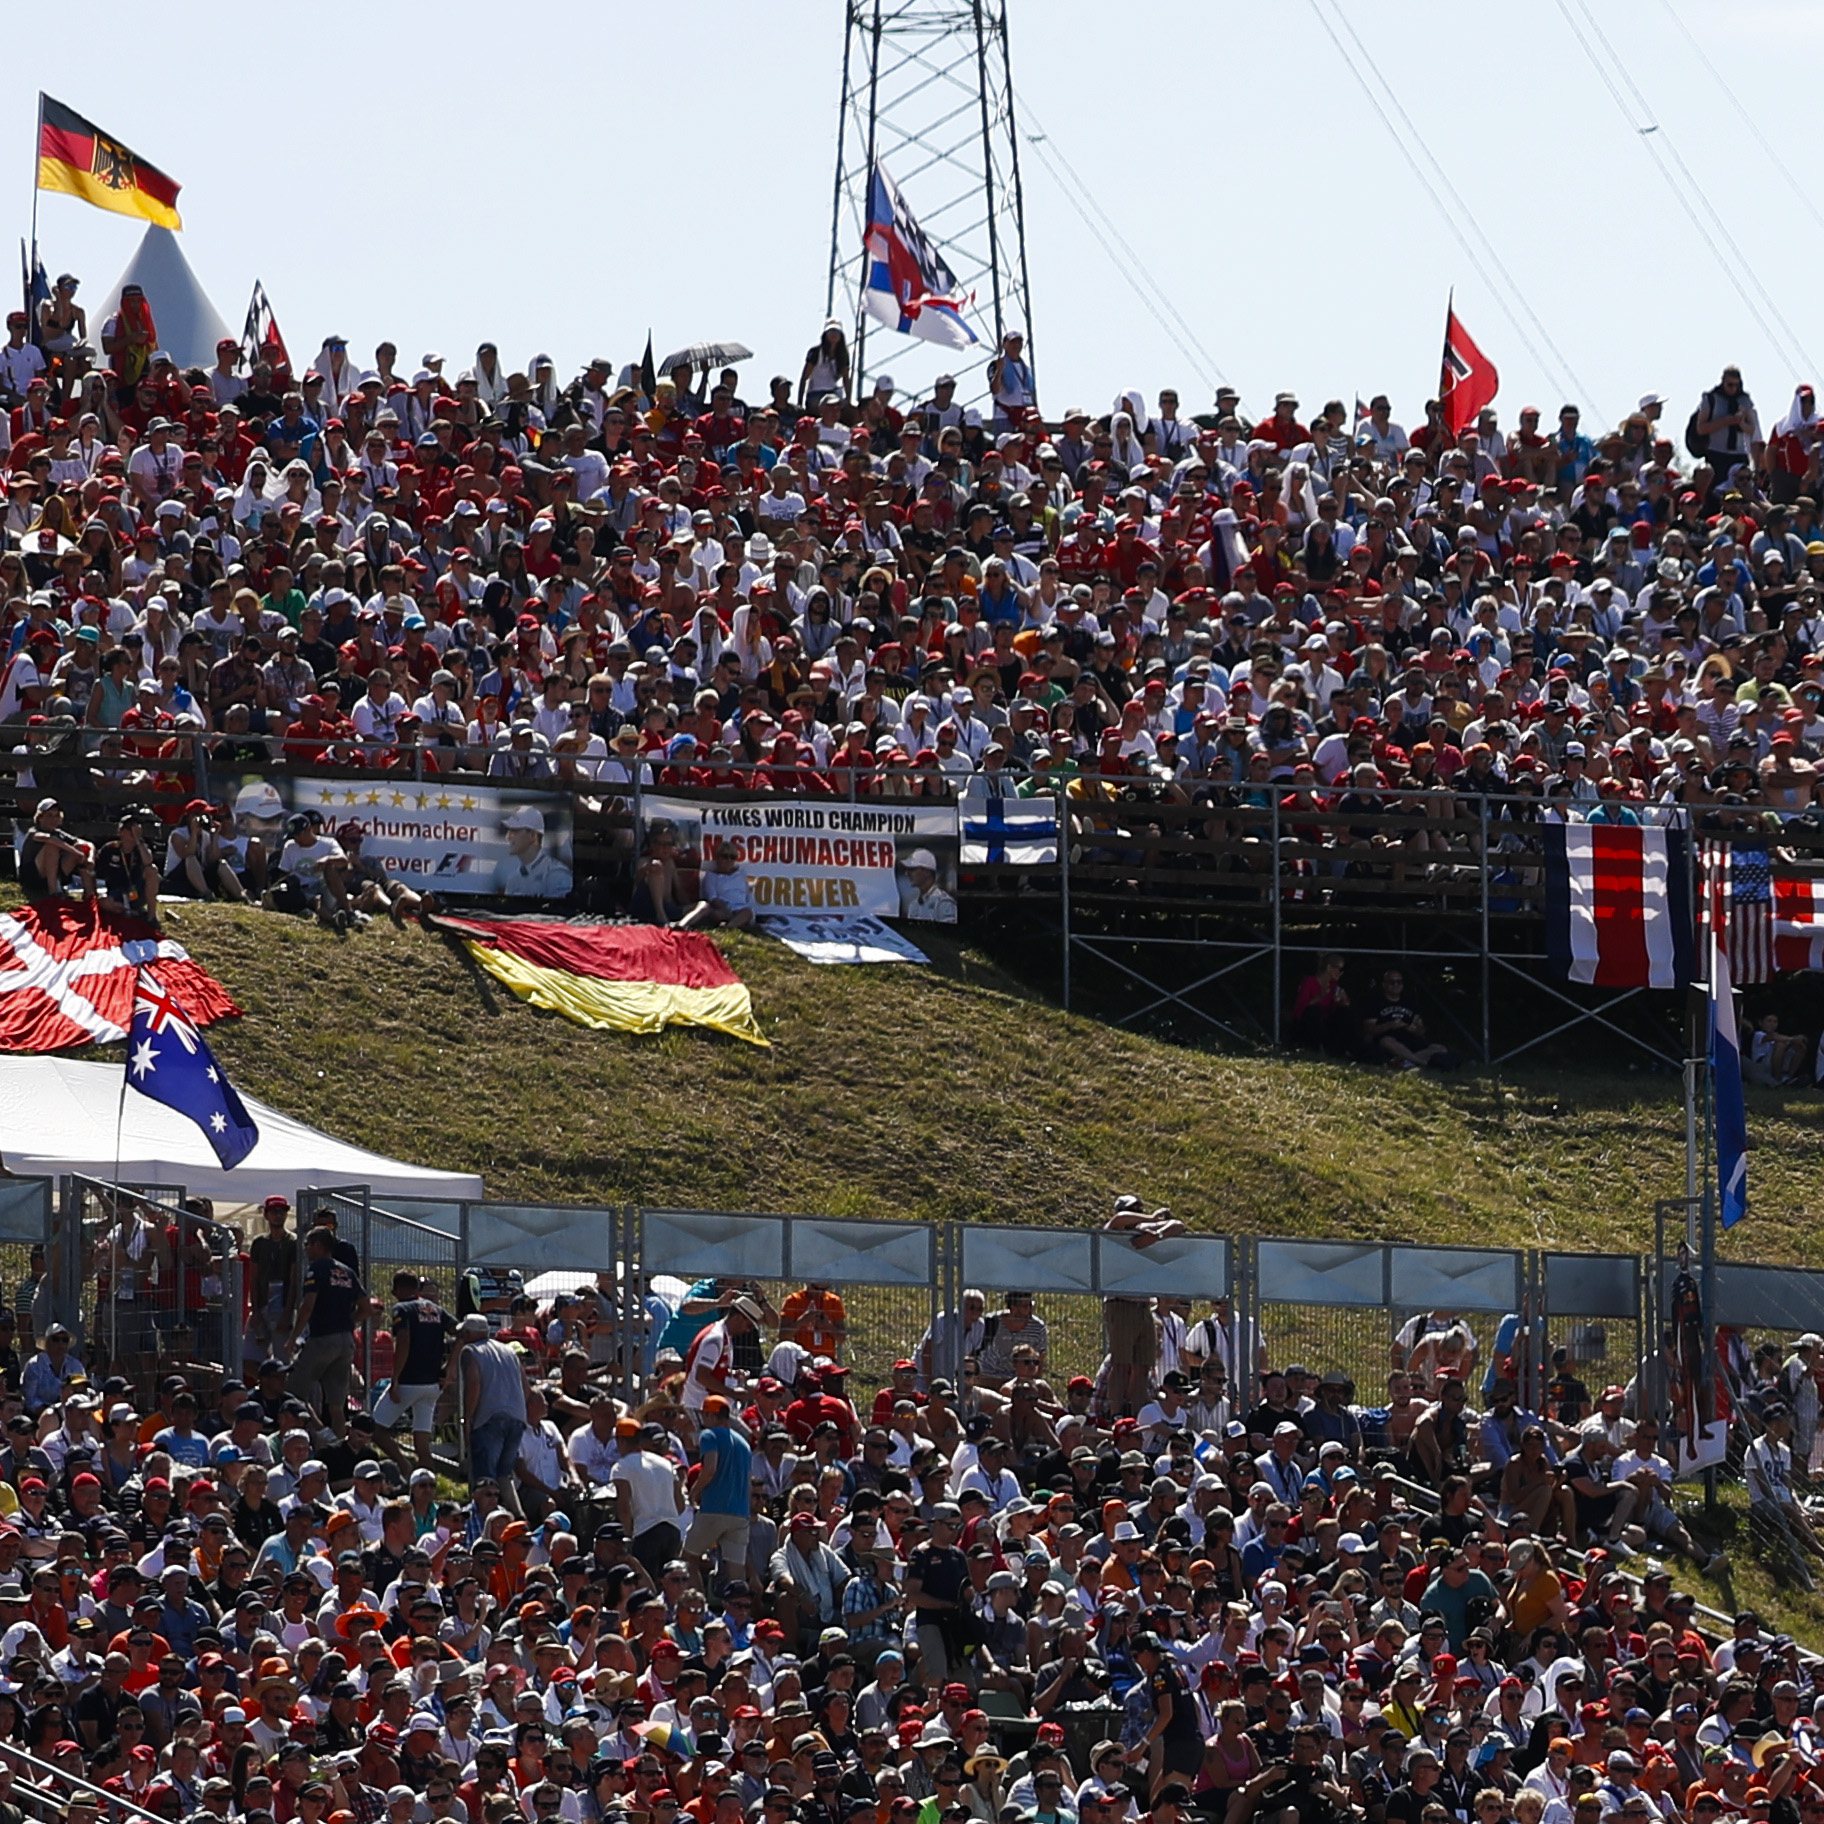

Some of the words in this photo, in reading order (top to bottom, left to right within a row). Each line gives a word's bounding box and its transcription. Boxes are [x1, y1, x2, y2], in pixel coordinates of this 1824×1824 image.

[700, 808, 708, 826] 7
[709, 808, 762, 828] TIMES
[765, 809, 825, 831] WORLD
[828, 811, 916, 834] CHAMPION
[380, 857, 431, 873] rever
